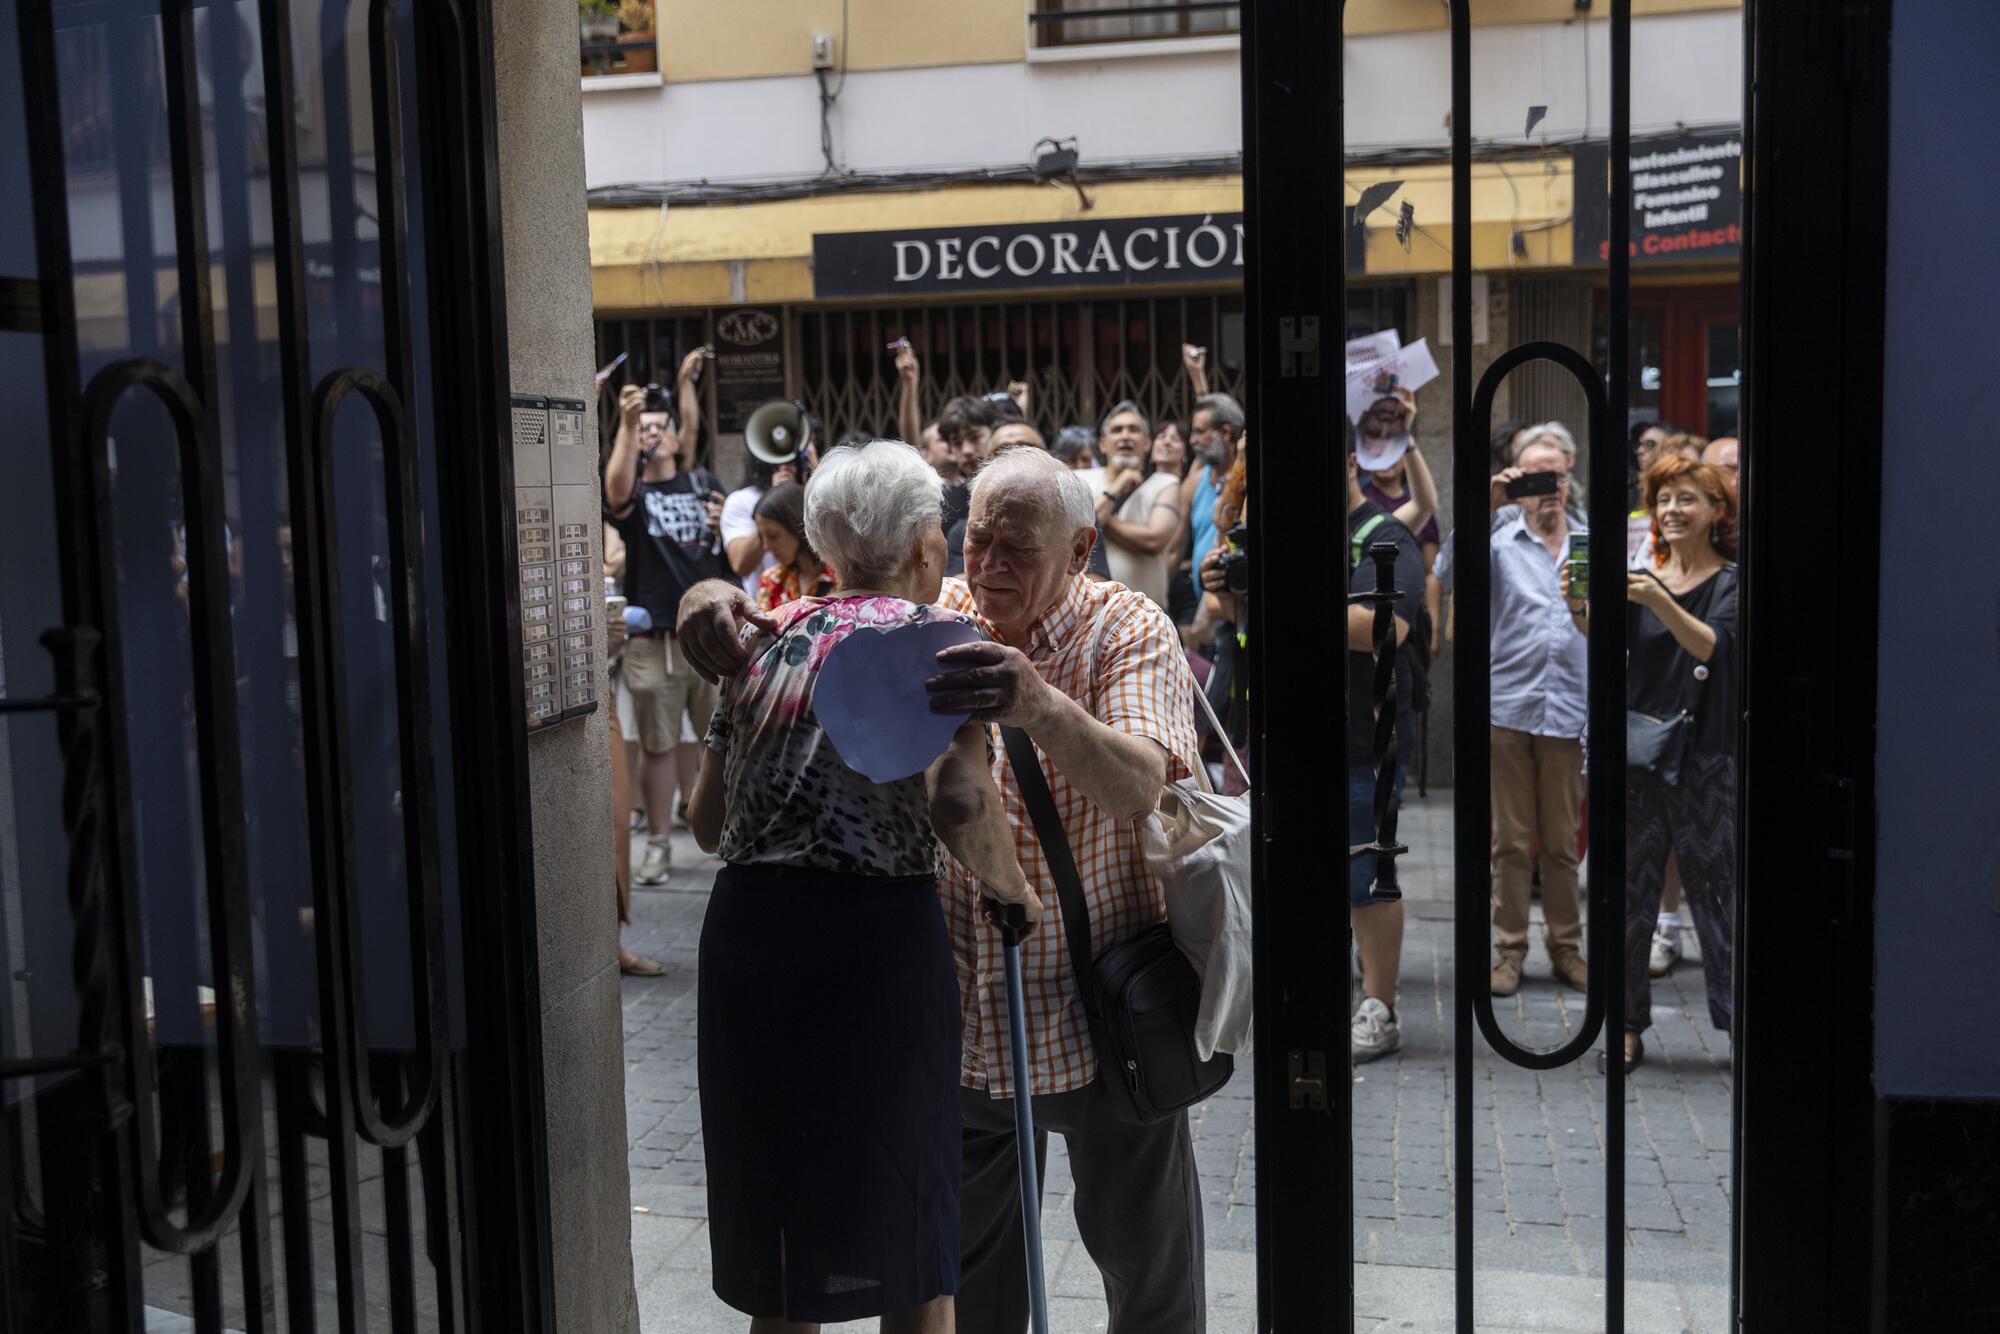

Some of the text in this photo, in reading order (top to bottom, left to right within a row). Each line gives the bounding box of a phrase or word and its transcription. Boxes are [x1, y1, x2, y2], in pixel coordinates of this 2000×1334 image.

[1633, 165, 1724, 191] Masculino
[1644, 203, 1709, 228] Infantil
[1643, 224, 1740, 254] Contact
